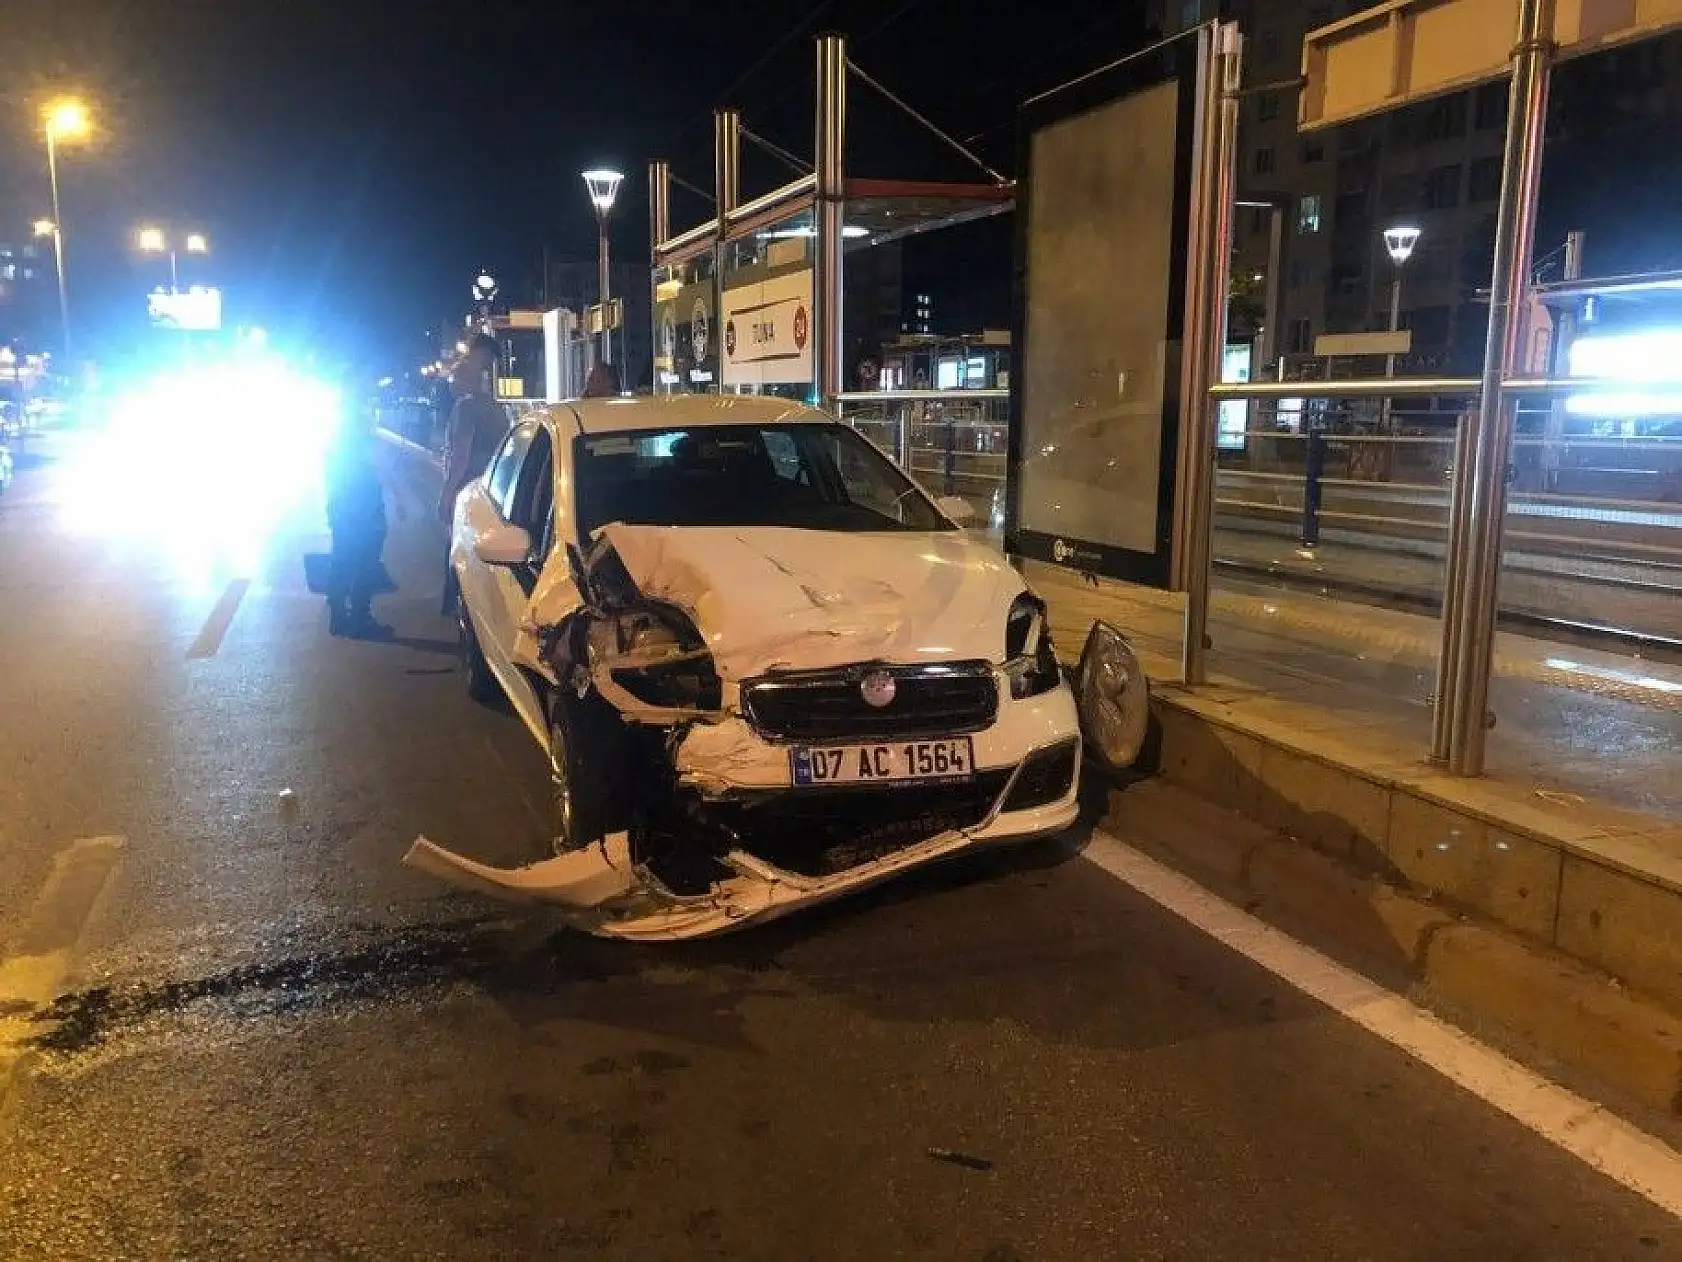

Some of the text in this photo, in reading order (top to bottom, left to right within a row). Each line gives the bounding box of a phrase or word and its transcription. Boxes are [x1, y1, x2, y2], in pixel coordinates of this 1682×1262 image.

[812, 743, 964, 779] 07 AC 1564
